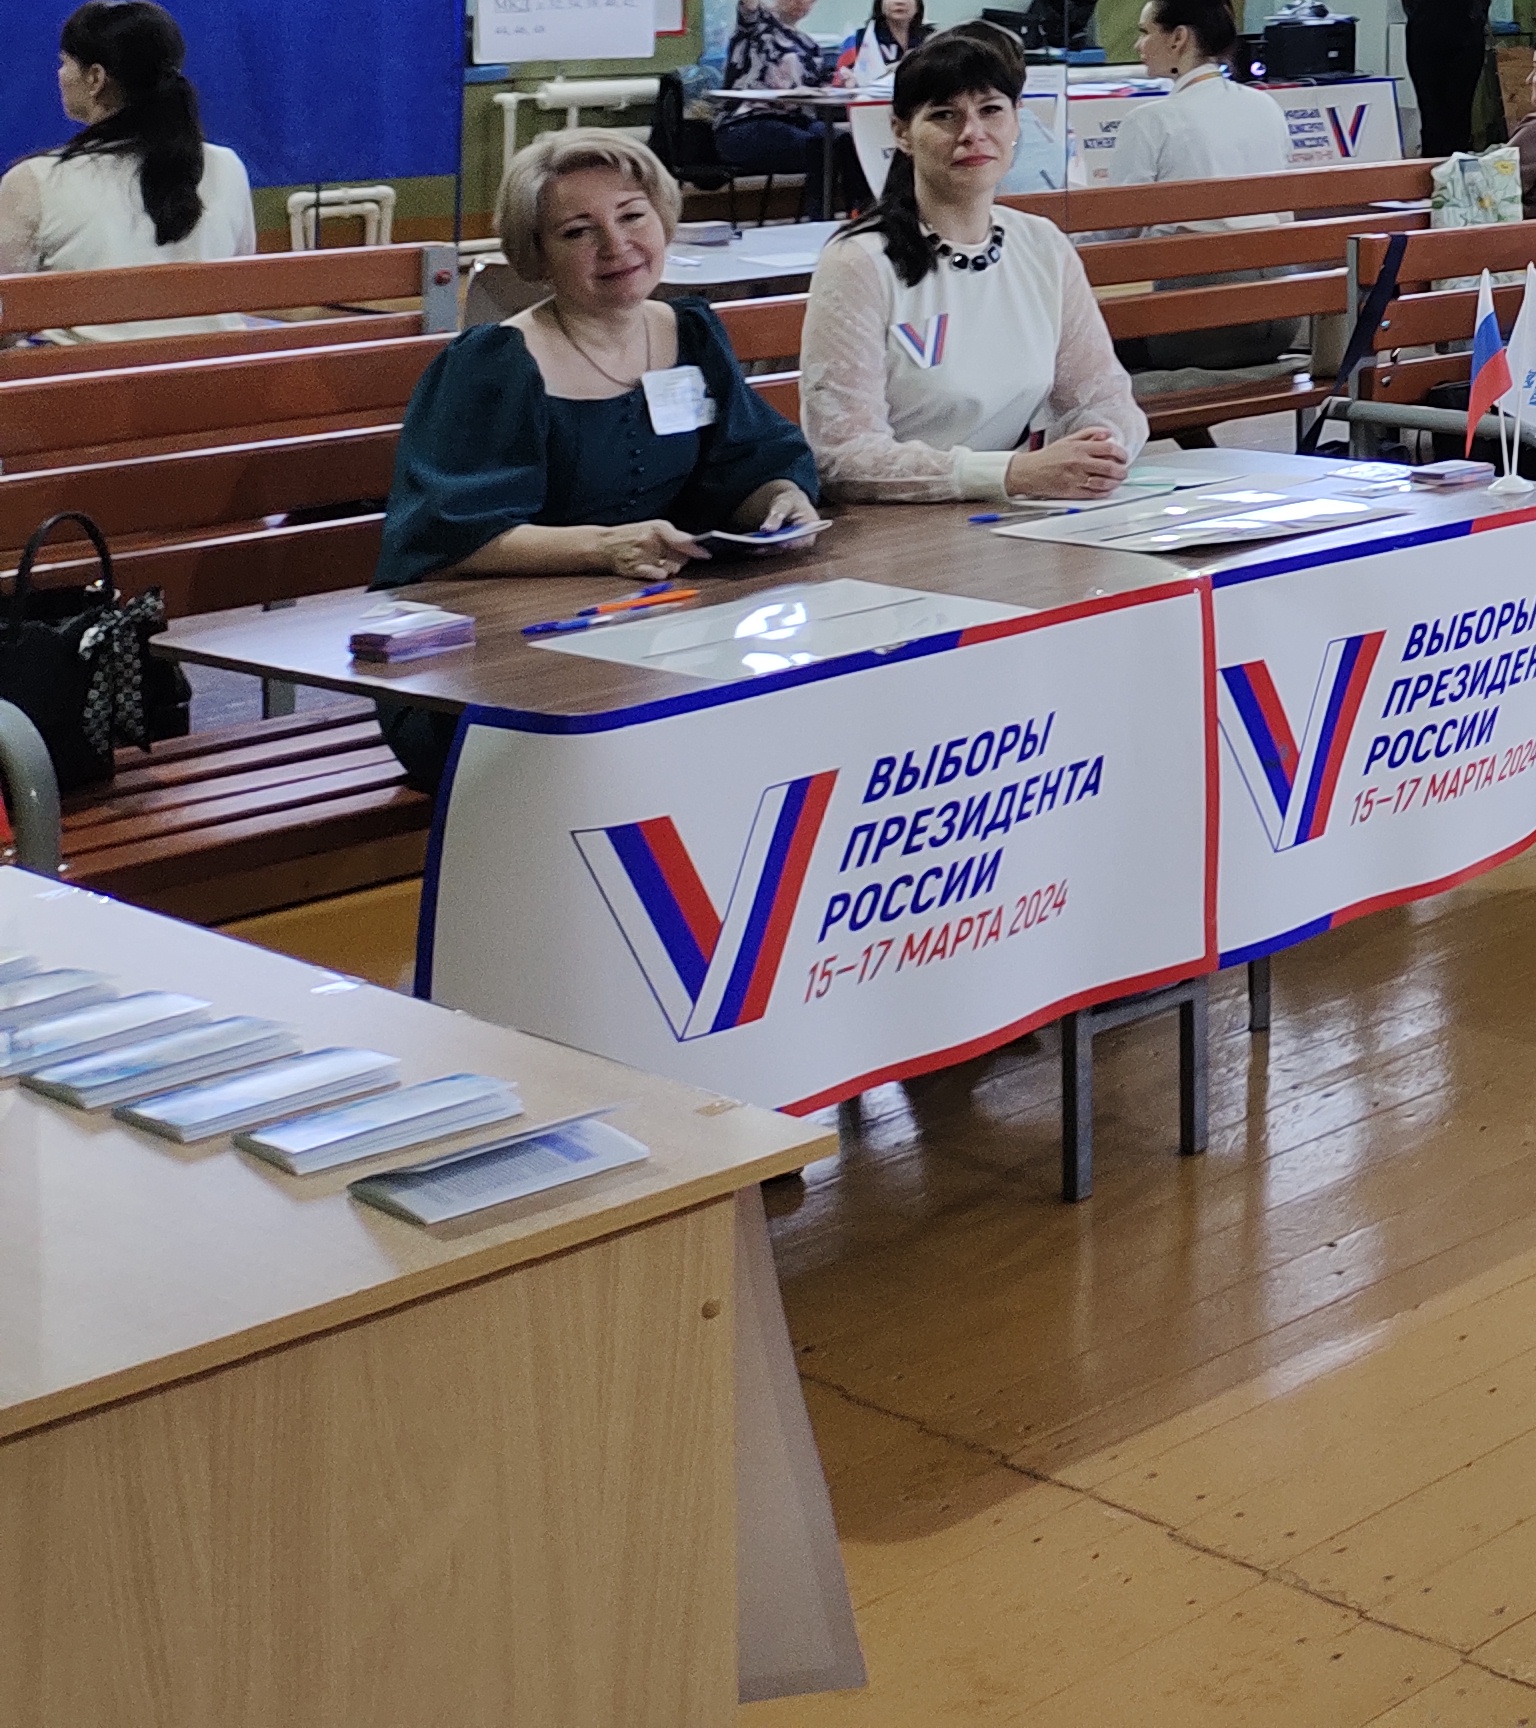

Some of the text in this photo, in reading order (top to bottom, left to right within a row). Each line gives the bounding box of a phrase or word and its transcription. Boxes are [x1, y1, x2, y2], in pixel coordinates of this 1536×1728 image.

[861, 710, 1057, 805] ВЫБОРЫ
[1361, 704, 1501, 777] РОССИИ
[1421, 753, 1498, 808] МАРТА
[838, 754, 1106, 874] ПРЕЗИДЕНТА
[816, 846, 1005, 944] РОССИИ
[895, 904, 1005, 973] МАРТА
[1006, 878, 1069, 939] 2024
